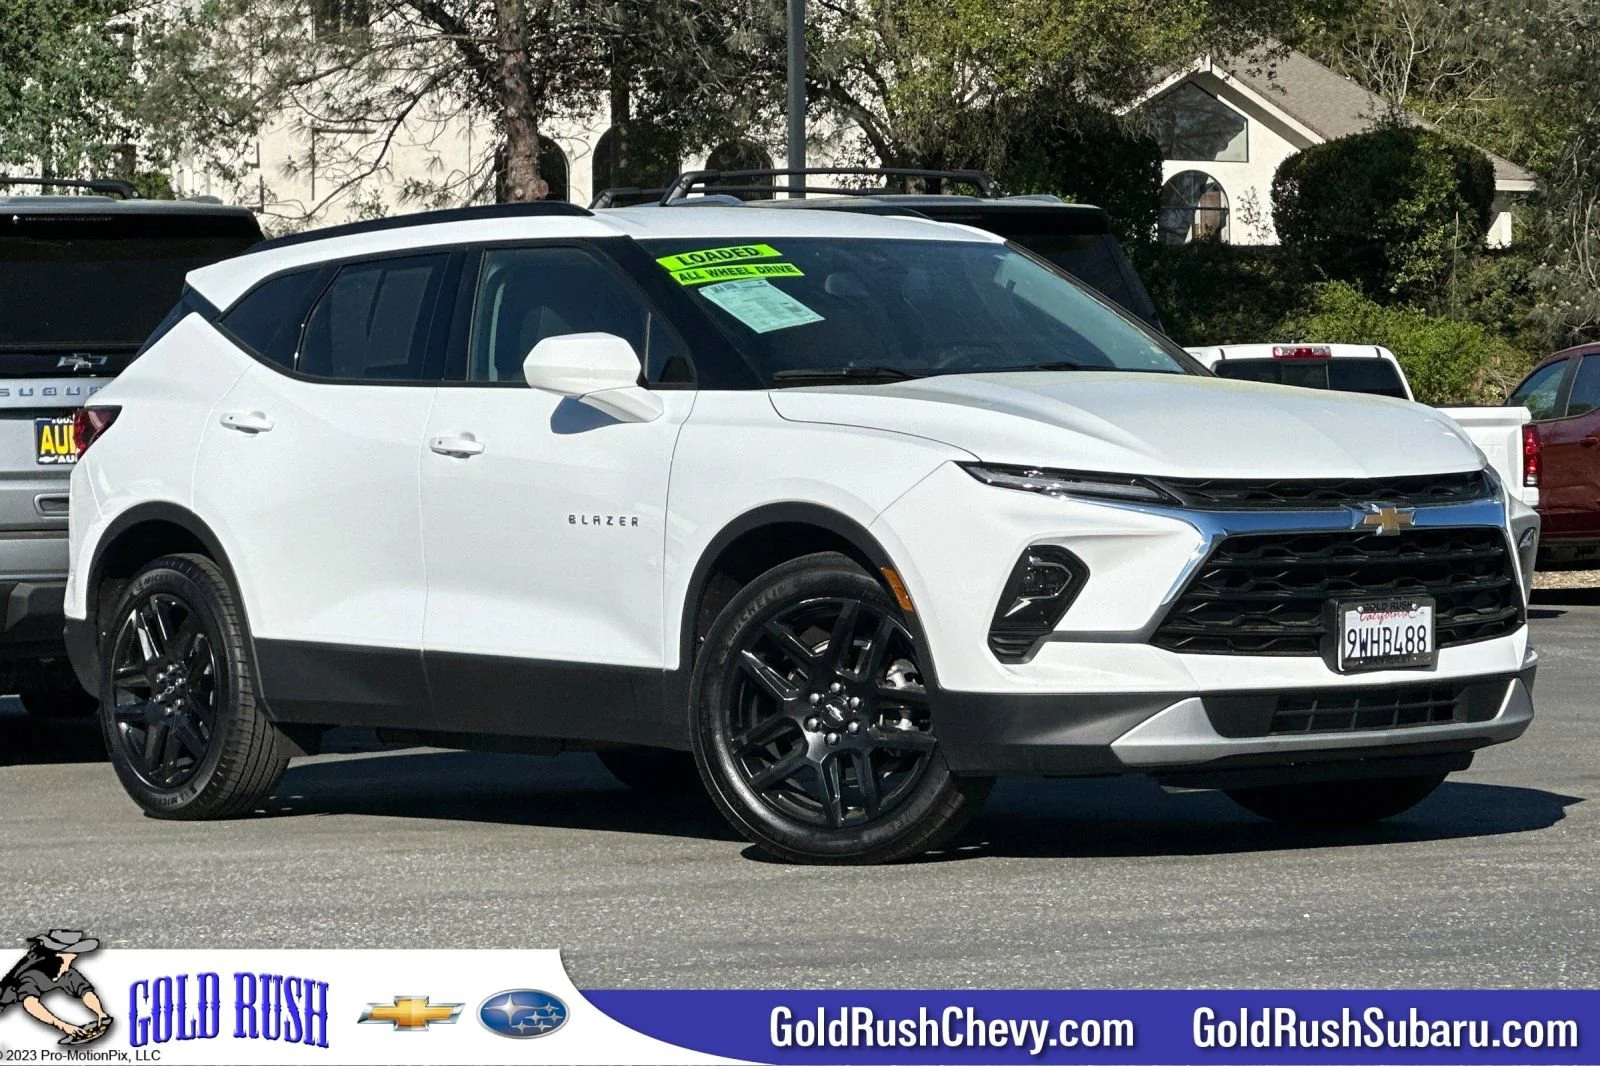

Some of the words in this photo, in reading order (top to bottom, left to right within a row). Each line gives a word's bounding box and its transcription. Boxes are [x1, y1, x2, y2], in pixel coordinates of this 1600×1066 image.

[676, 246, 761, 266] LOADED
[679, 271, 705, 282] ALL
[707, 267, 754, 278] WHEEL
[757, 265, 799, 274] DRIVE
[568, 514, 639, 527] BLAZER
[1347, 624, 1427, 658] 9WHB488
